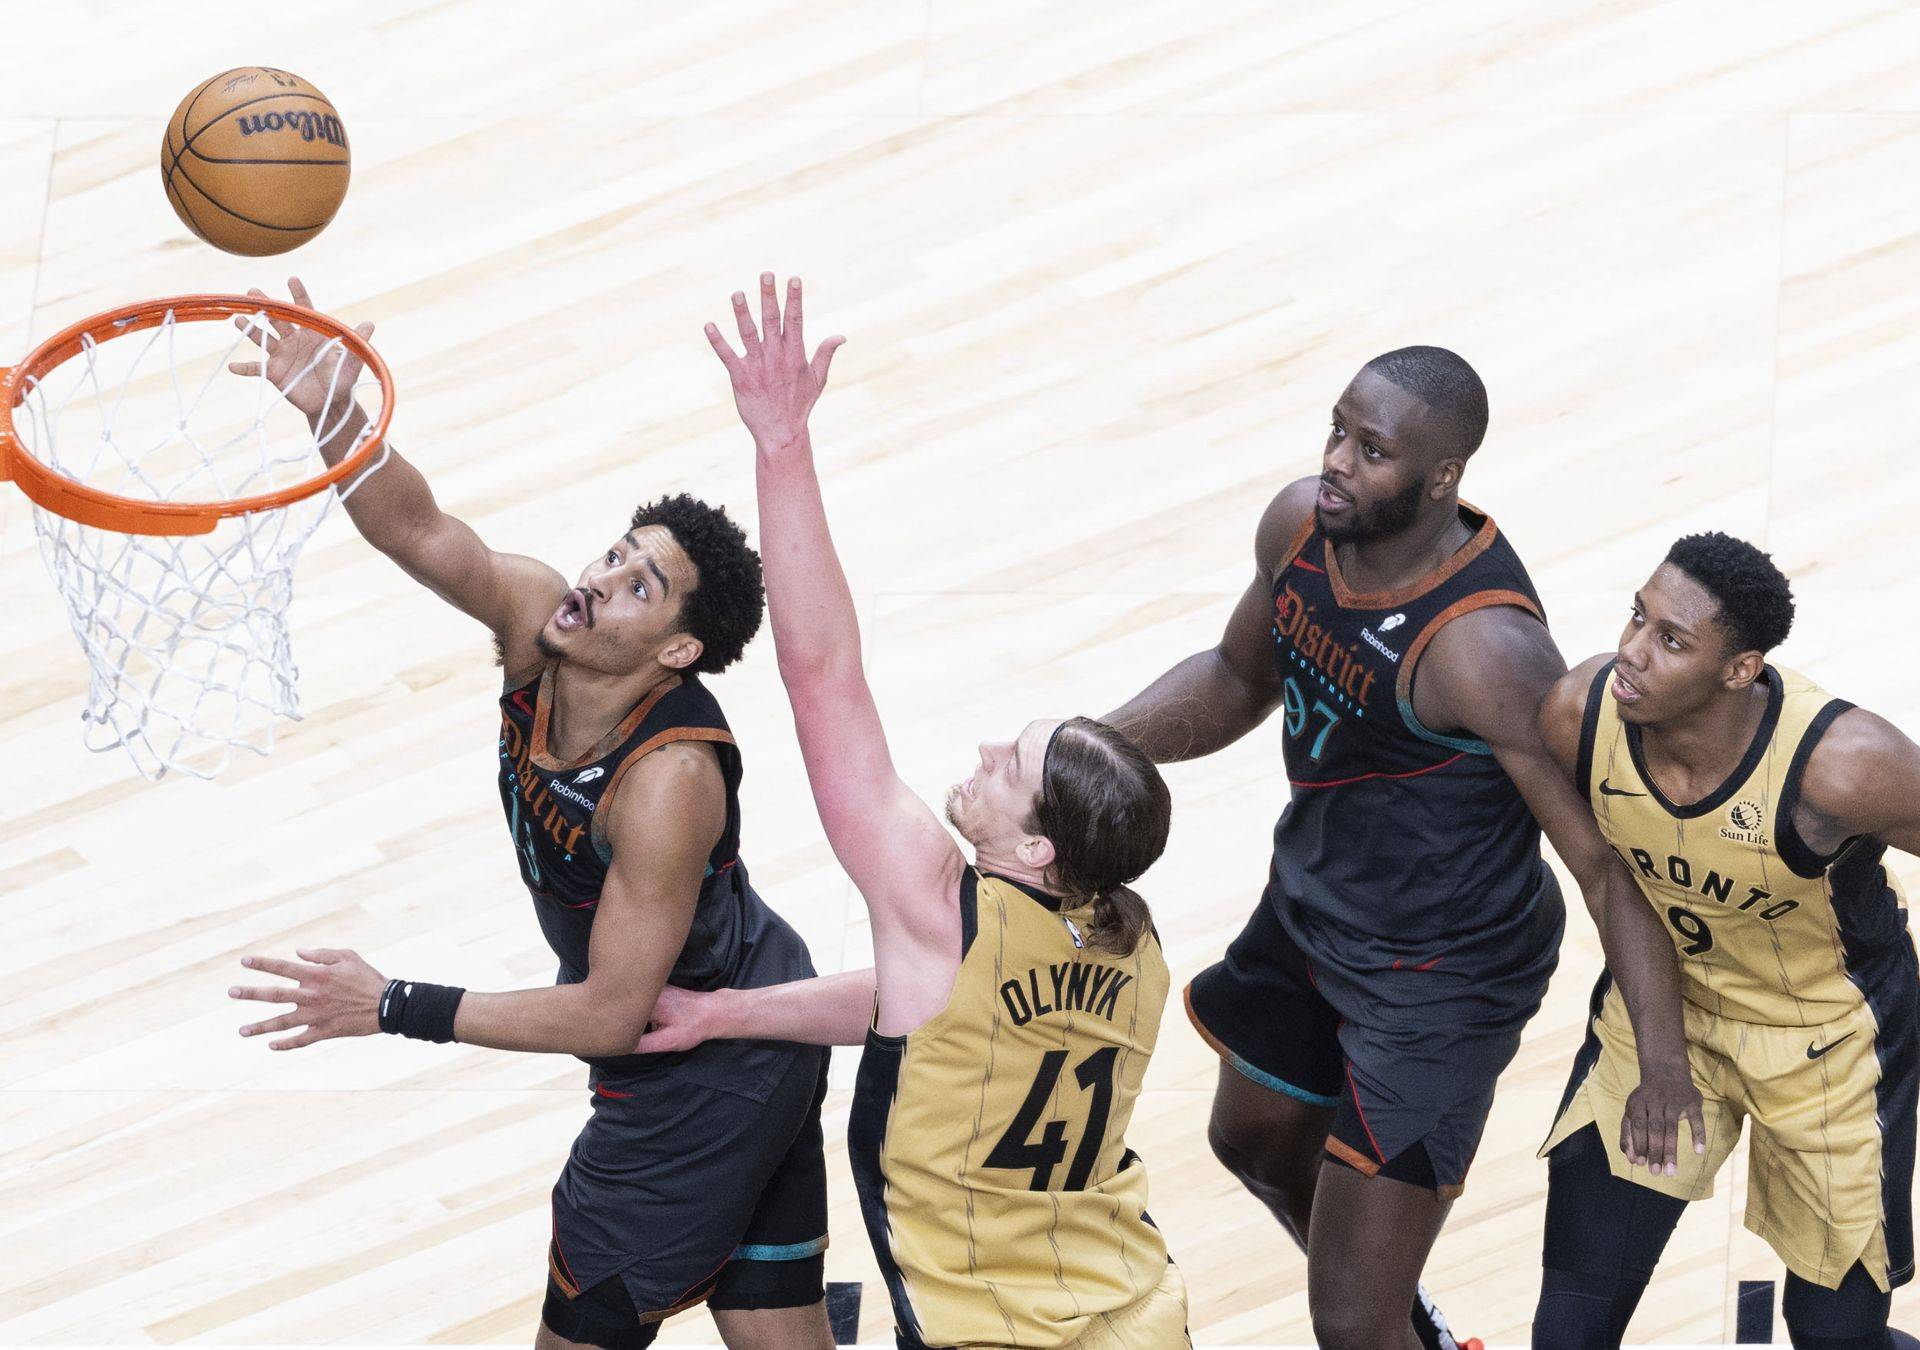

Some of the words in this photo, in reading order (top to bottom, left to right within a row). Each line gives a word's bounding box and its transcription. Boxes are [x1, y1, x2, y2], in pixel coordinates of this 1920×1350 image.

[236, 111, 347, 148] Wilson
[1275, 581, 1376, 706] District
[1360, 627, 1399, 663] Robinhood
[1284, 678, 1341, 760] 97
[550, 779, 595, 812] Robinhoo
[1720, 828, 1744, 841] Sun
[1747, 832, 1769, 846] Life
[1609, 843, 1799, 921] RONTO
[1667, 906, 1713, 957] 9
[1000, 961, 1133, 1026] OLYNYK
[982, 1047, 1120, 1191] 41
